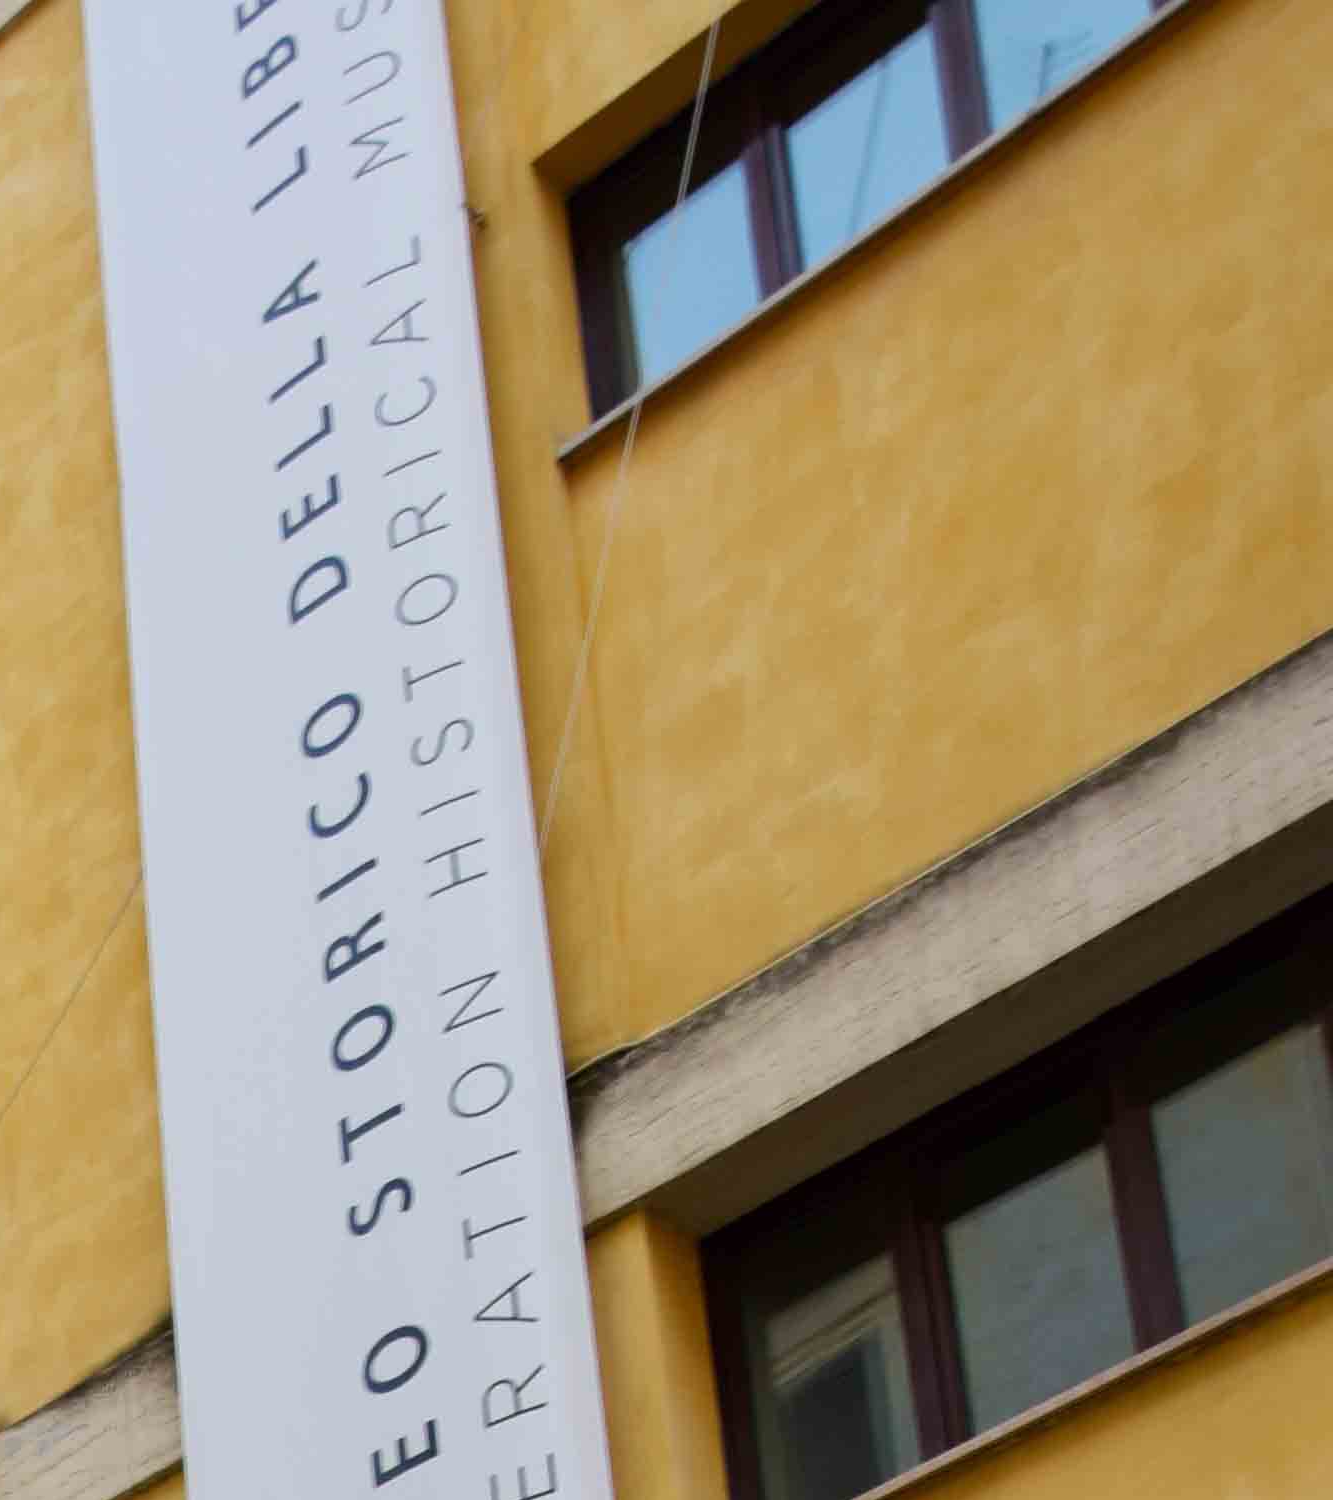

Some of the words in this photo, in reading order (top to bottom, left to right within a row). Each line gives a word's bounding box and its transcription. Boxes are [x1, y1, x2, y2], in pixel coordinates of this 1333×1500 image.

[262, 257, 352, 626] DELLA
[366, 234, 489, 899] HISTORICAL
[299, 690, 416, 1238] STORICO
